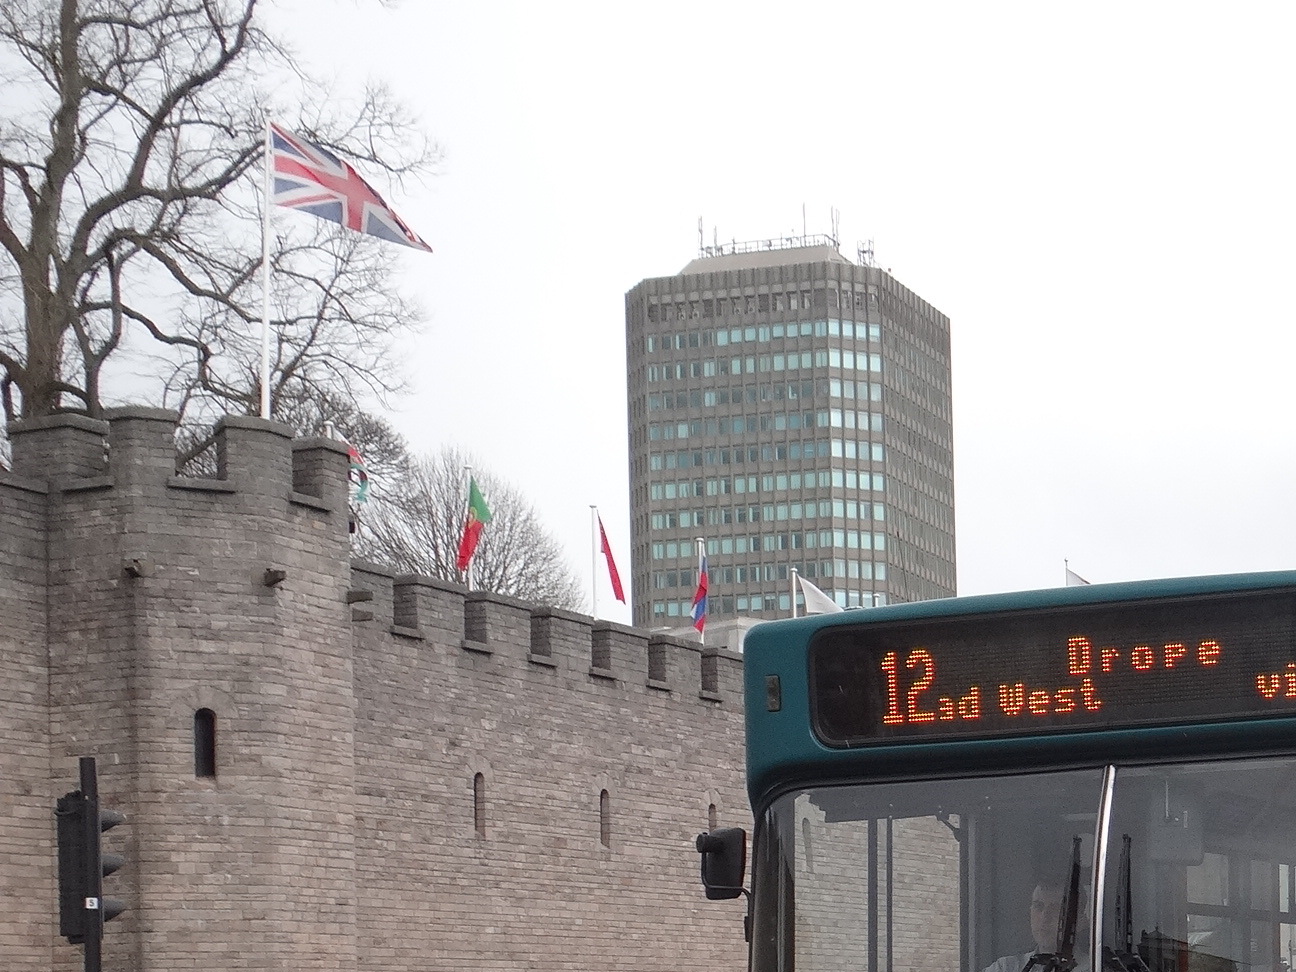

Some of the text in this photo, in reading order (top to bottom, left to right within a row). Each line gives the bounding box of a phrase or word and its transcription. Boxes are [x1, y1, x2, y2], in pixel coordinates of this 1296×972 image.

[1067, 635, 1223, 676] Drope
[880, 648, 937, 726] 12
[998, 678, 1103, 716] West
